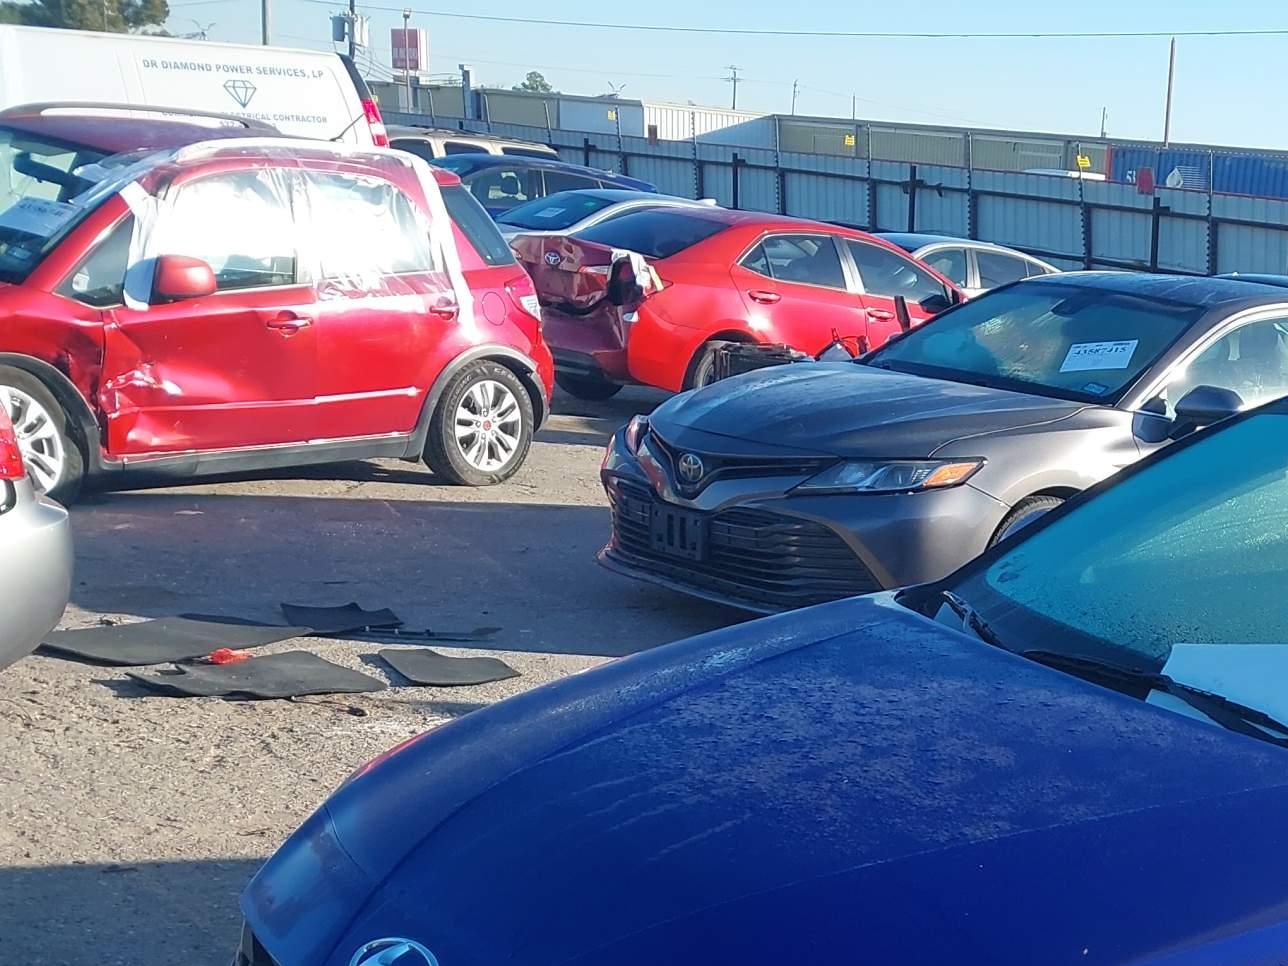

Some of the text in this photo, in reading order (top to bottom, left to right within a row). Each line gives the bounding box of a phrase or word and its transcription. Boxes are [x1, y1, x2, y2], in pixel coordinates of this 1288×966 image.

[142, 59, 325, 79] DR DIAMOND POWER SERVICES, LP
[272, 113, 328, 123] CONTRACTOR
